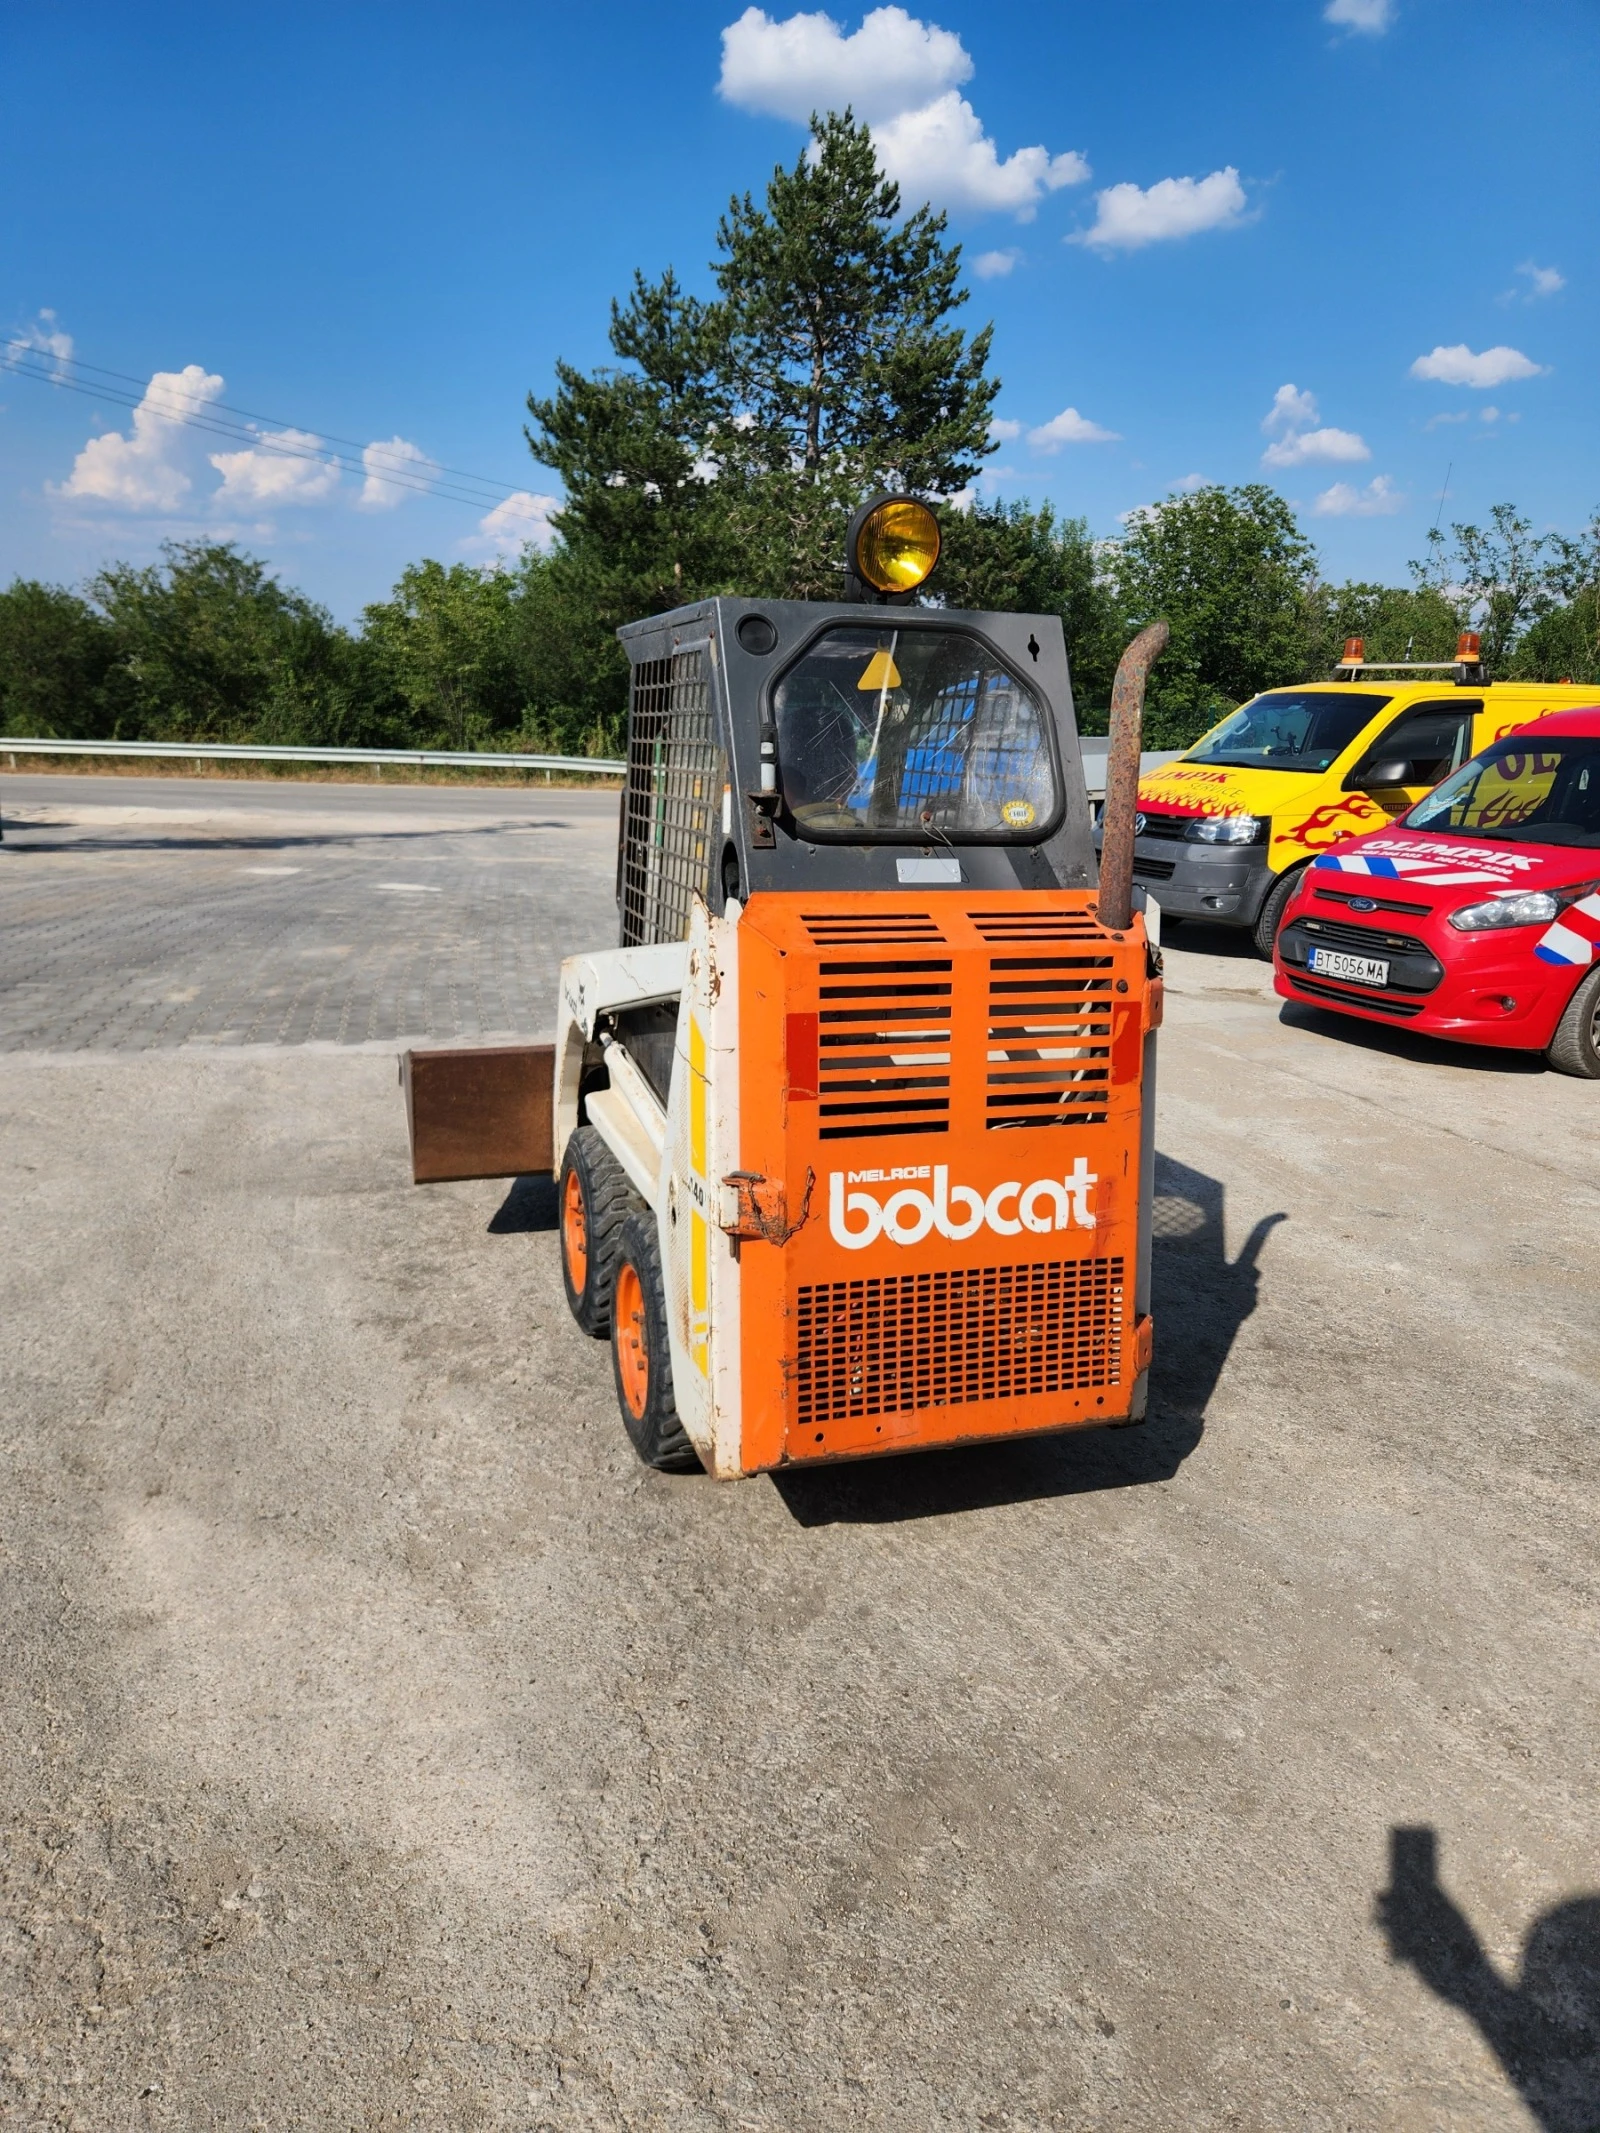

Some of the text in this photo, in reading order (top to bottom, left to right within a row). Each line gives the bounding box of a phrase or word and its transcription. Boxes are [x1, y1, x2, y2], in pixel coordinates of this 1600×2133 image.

[1185, 782, 1244, 798] SERVICE
[1361, 840, 1544, 871] OLIMPIK
[1316, 952, 1332, 968] BT
[1334, 955, 1364, 975] 5056
[1366, 962, 1384, 980] MA
[847, 1165, 931, 1184] MELROE
[829, 1157, 1098, 1250] bobcat
